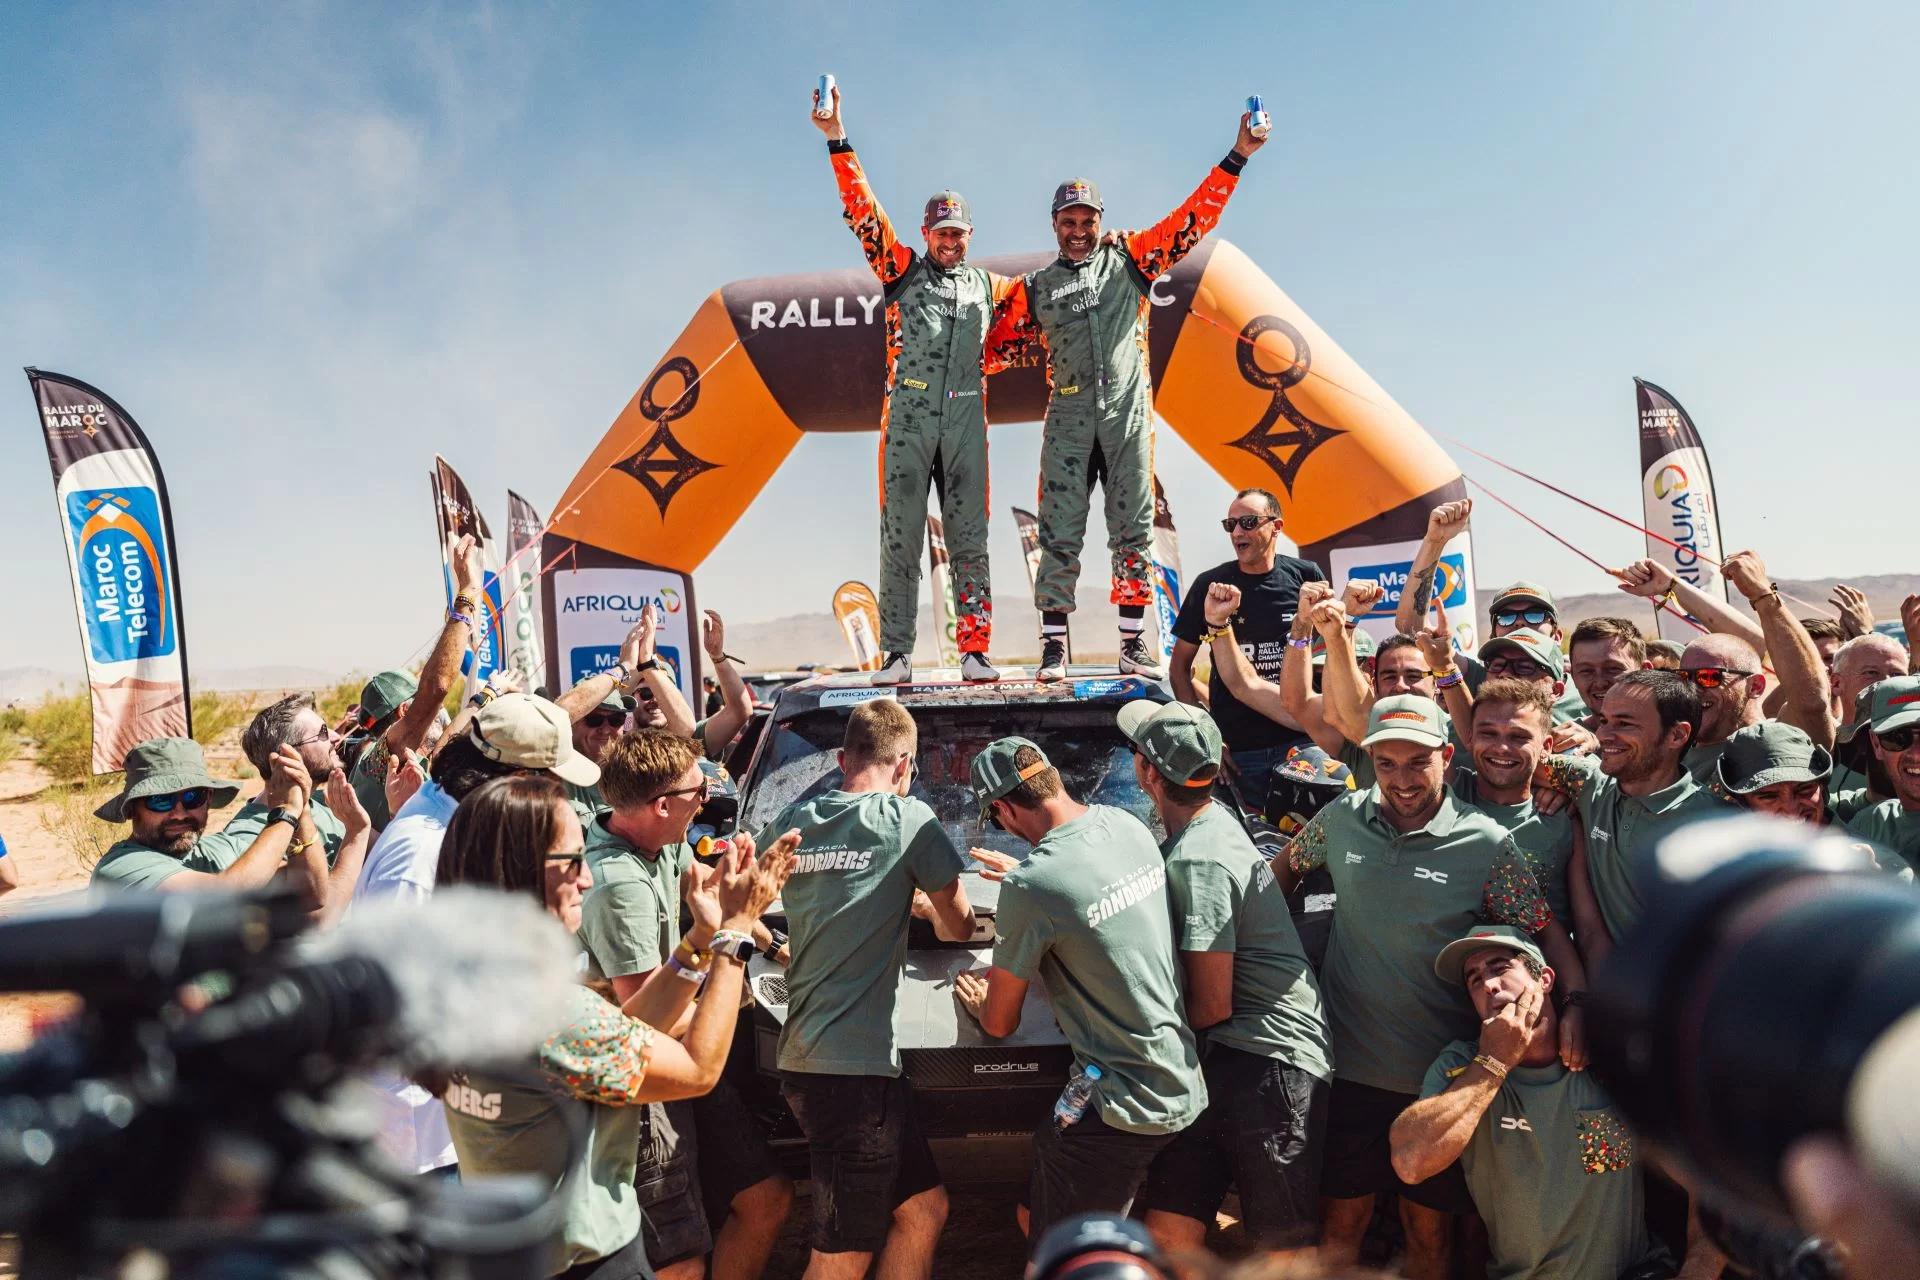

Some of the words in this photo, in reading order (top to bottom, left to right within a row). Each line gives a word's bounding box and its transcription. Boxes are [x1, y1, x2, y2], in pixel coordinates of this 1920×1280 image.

[1072, 298, 1100, 312] QATAR
[751, 295, 881, 330] RALLY
[43, 405, 85, 415] RALLYE
[88, 404, 105, 413] DU
[46, 414, 107, 428] MAROC
[1643, 416, 1680, 429] MAROC
[93, 543, 121, 622] Maroc
[120, 541, 148, 644] Telecom
[563, 595, 665, 613] AFRIQUIA
[1258, 641, 1279, 649] WORLD
[827, 690, 880, 699] AFRIQUIA
[817, 843, 848, 852] DACIA
[790, 850, 873, 873] NDRIDERS
[974, 1061, 1039, 1073] prodrive
